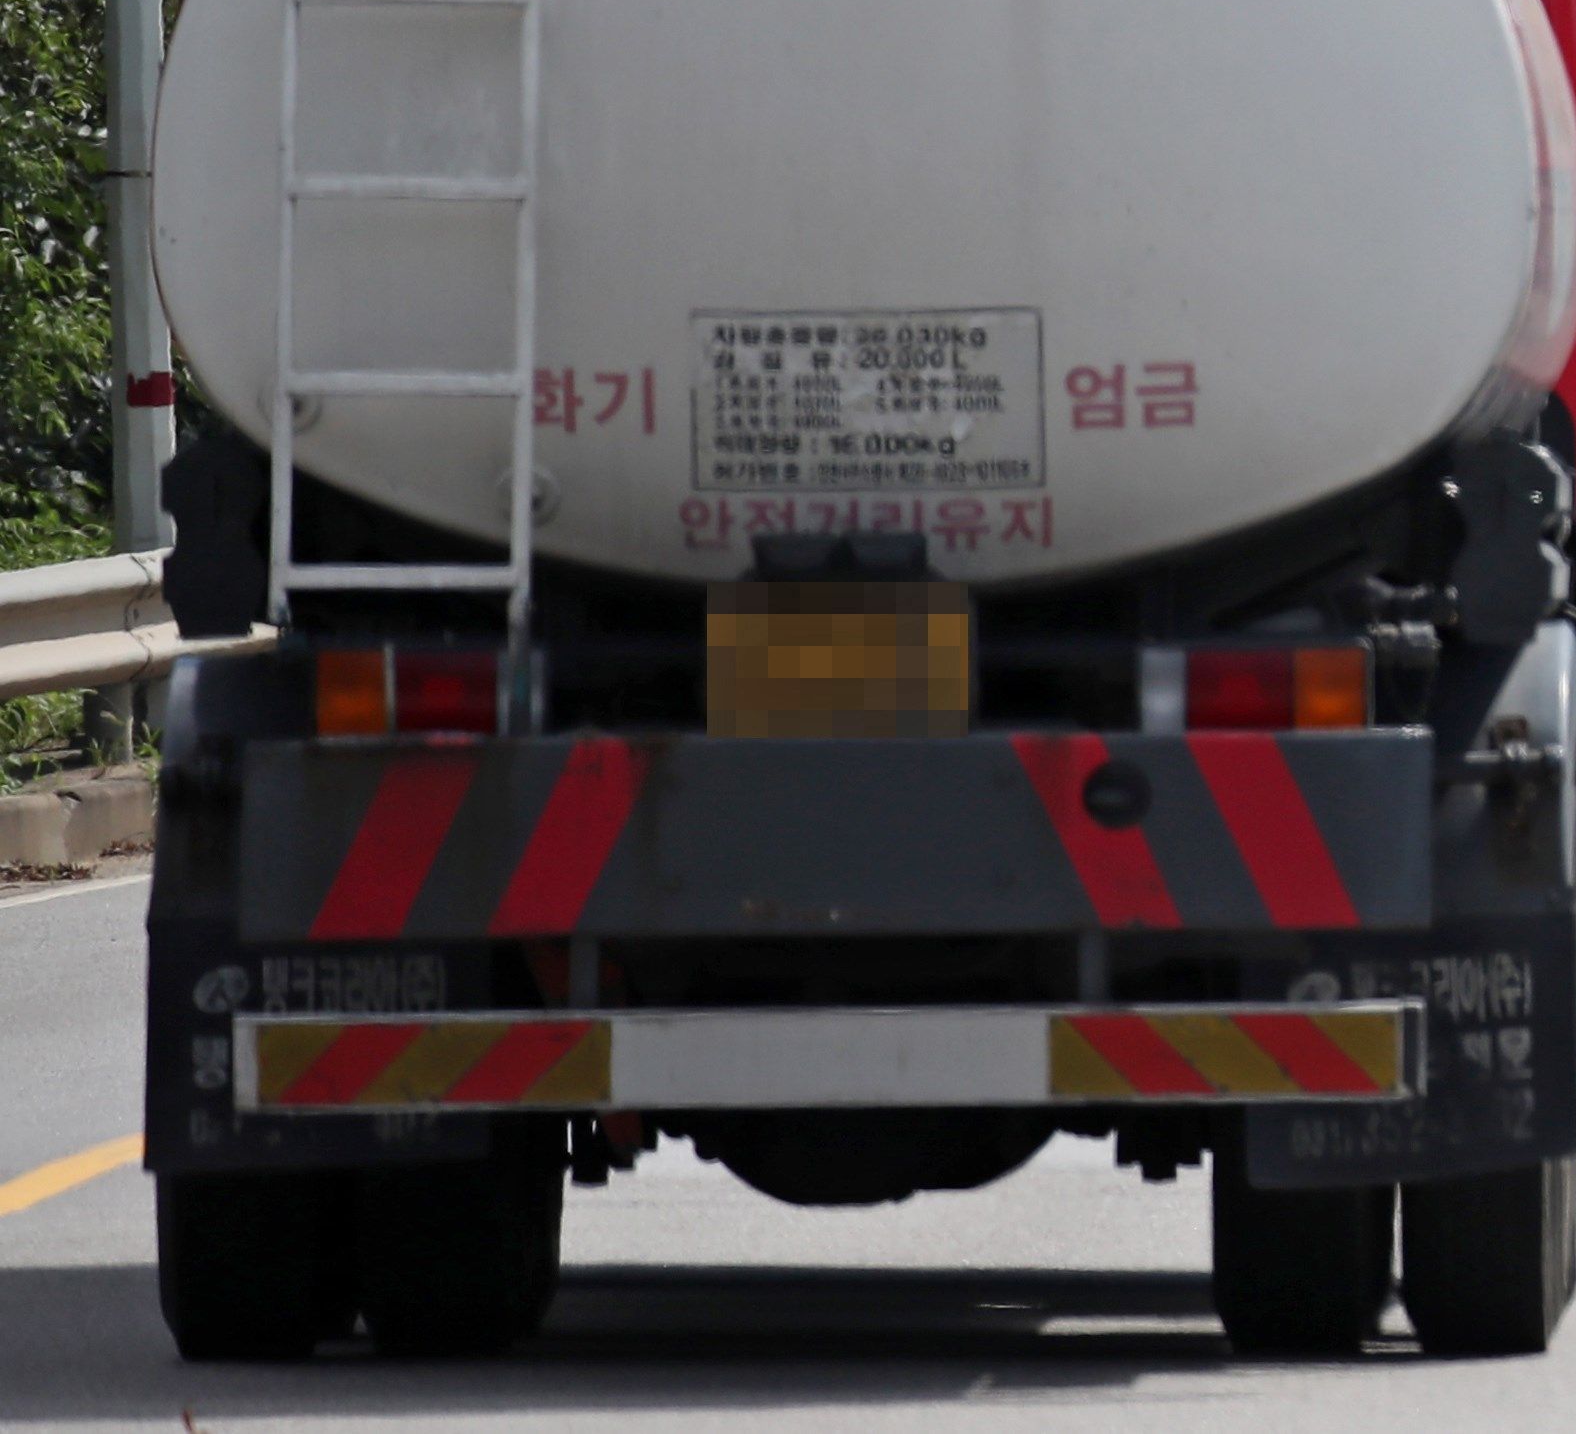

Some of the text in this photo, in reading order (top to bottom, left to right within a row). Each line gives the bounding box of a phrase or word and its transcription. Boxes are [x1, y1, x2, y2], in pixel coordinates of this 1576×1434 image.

[530, 366, 658, 437] 화기
[1064, 362, 1199, 433] 엄금
[678, 495, 1054, 550] 안전거리유지
